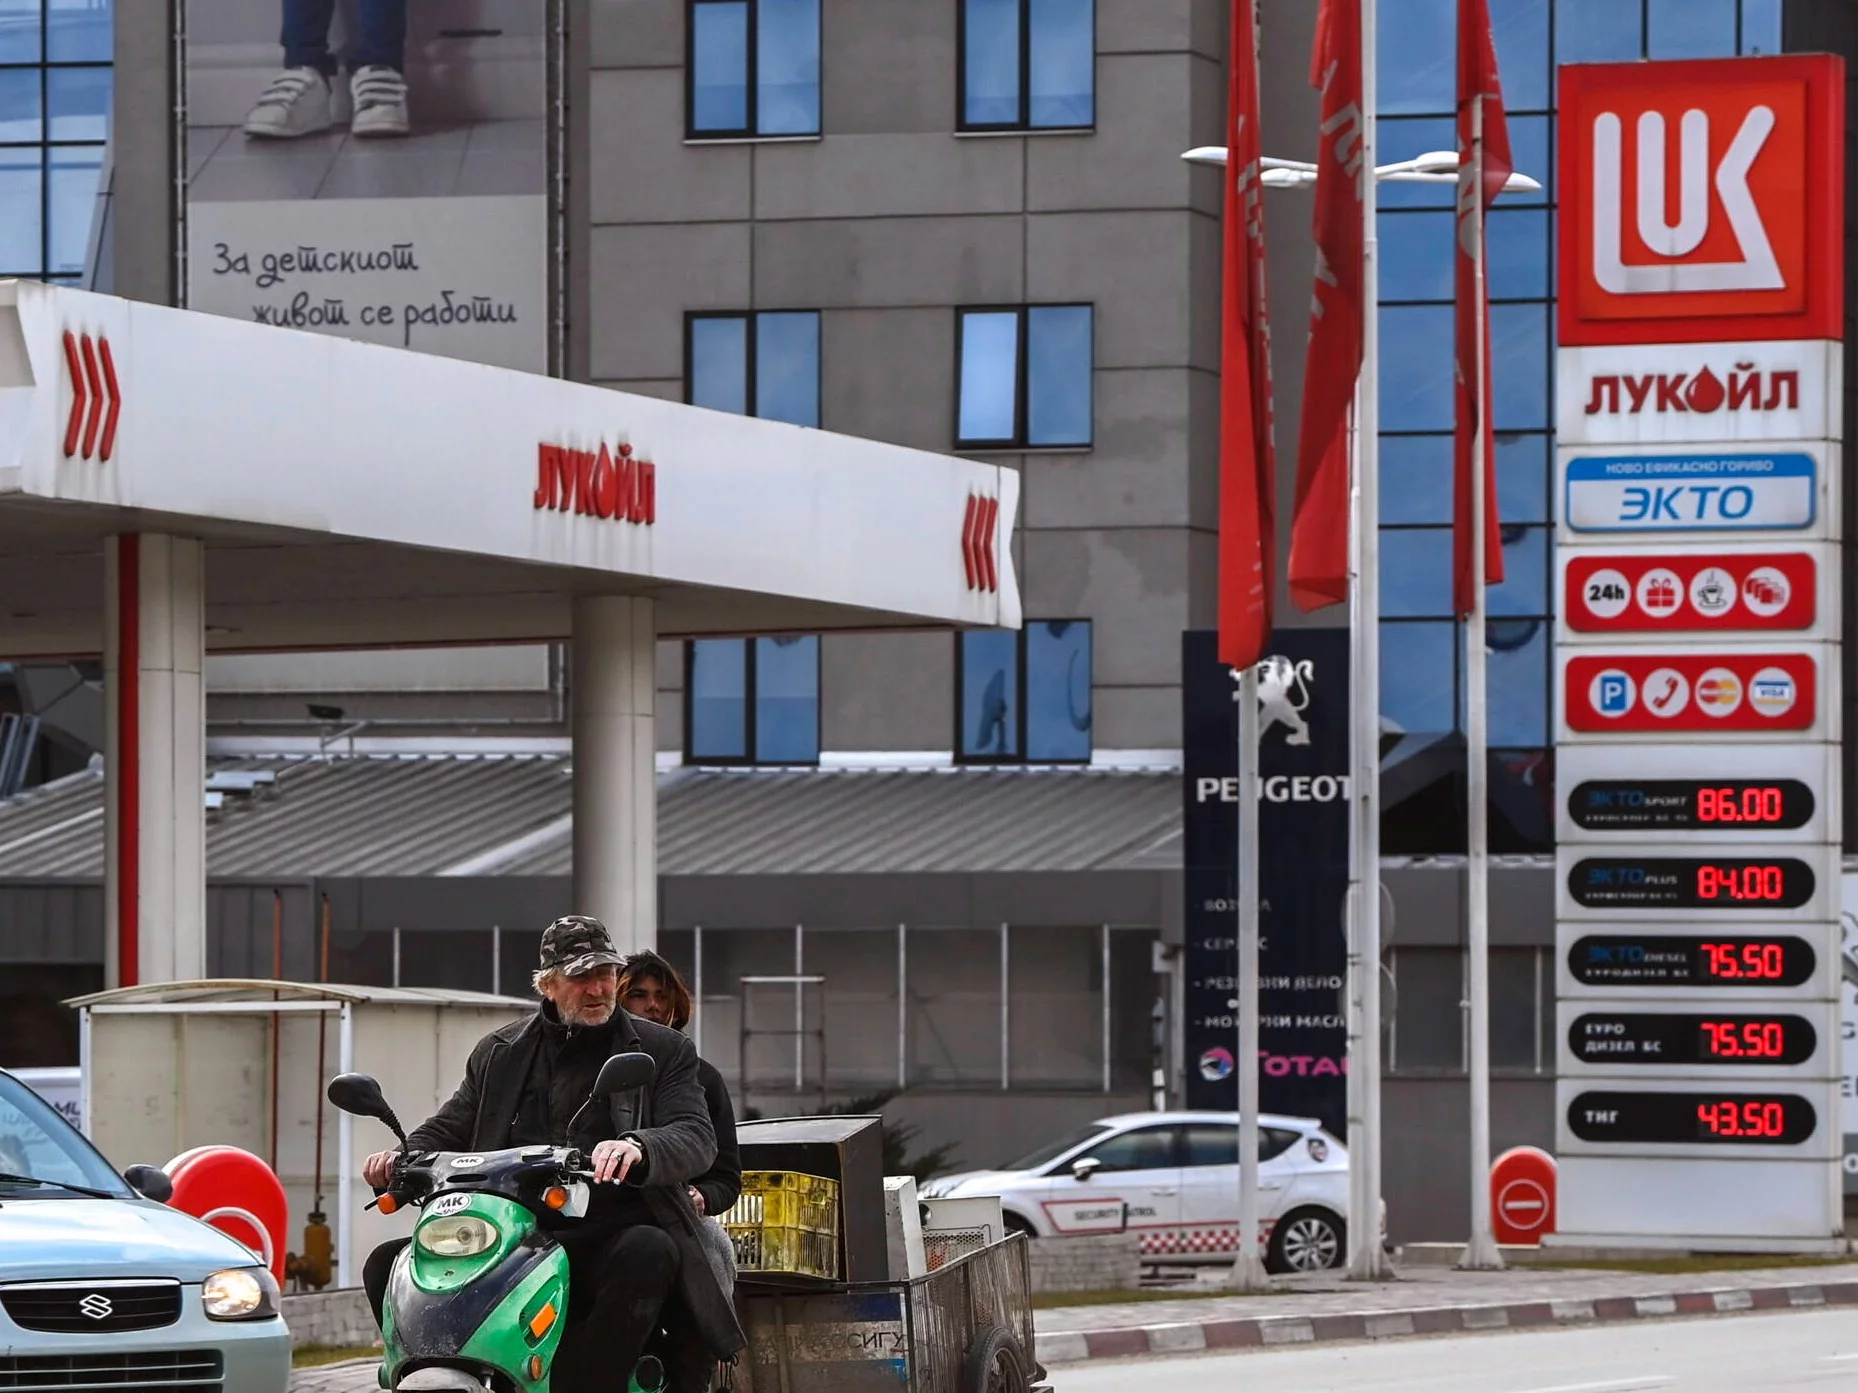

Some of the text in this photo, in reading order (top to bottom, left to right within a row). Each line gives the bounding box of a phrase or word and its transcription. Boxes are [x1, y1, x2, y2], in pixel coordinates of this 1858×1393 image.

[212, 243, 251, 274] За
[360, 304, 395, 326] се
[403, 290, 518, 346] работи
[1585, 363, 1800, 416] ЛУКОЙЛ
[1606, 463, 1643, 474] НОВО
[1619, 485, 1755, 521] ЭКТО
[1589, 584, 1626, 602] 24h
[1698, 788, 1783, 822] 86.00
[1698, 866, 1783, 899] 84.00
[1204, 898, 1272, 912] ВОЗА
[1203, 937, 1269, 950] СЕРС
[1700, 944, 1784, 978] 75.50
[1204, 976, 1290, 990] РЕЗВНИ
[1700, 1022, 1784, 1058] 75.50
[1258, 1049, 1350, 1077] OTA
[1584, 1102, 1785, 1137] ТНГ 43.50
[437, 1196, 464, 1209] MK
[1121, 1206, 1157, 1217] ATROL
